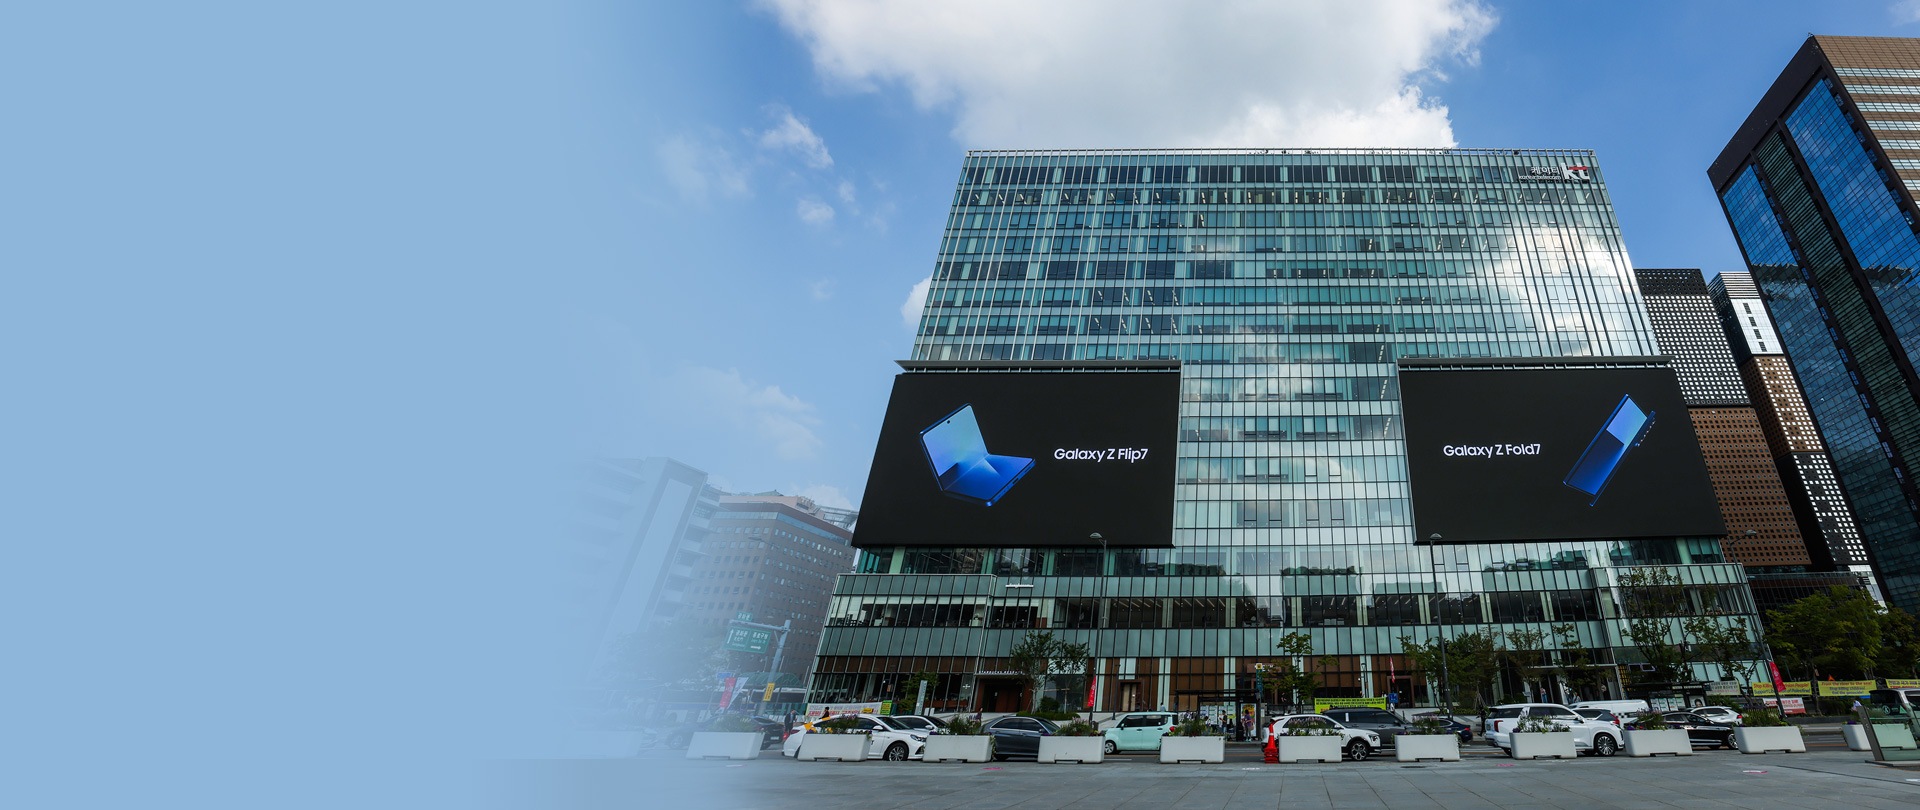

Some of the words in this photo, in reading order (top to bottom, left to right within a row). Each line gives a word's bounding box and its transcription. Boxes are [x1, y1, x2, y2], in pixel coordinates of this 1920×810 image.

[1531, 166, 1560, 174] 케이티
[1561, 163, 1590, 180] kt
[1054, 448, 1105, 463] Galaxy
[1106, 448, 1116, 460] Z
[1117, 447, 1149, 464] Flip7
[1443, 445, 1493, 458] Galaxy
[1495, 444, 1504, 456] Z
[1505, 443, 1541, 456] Fold7
